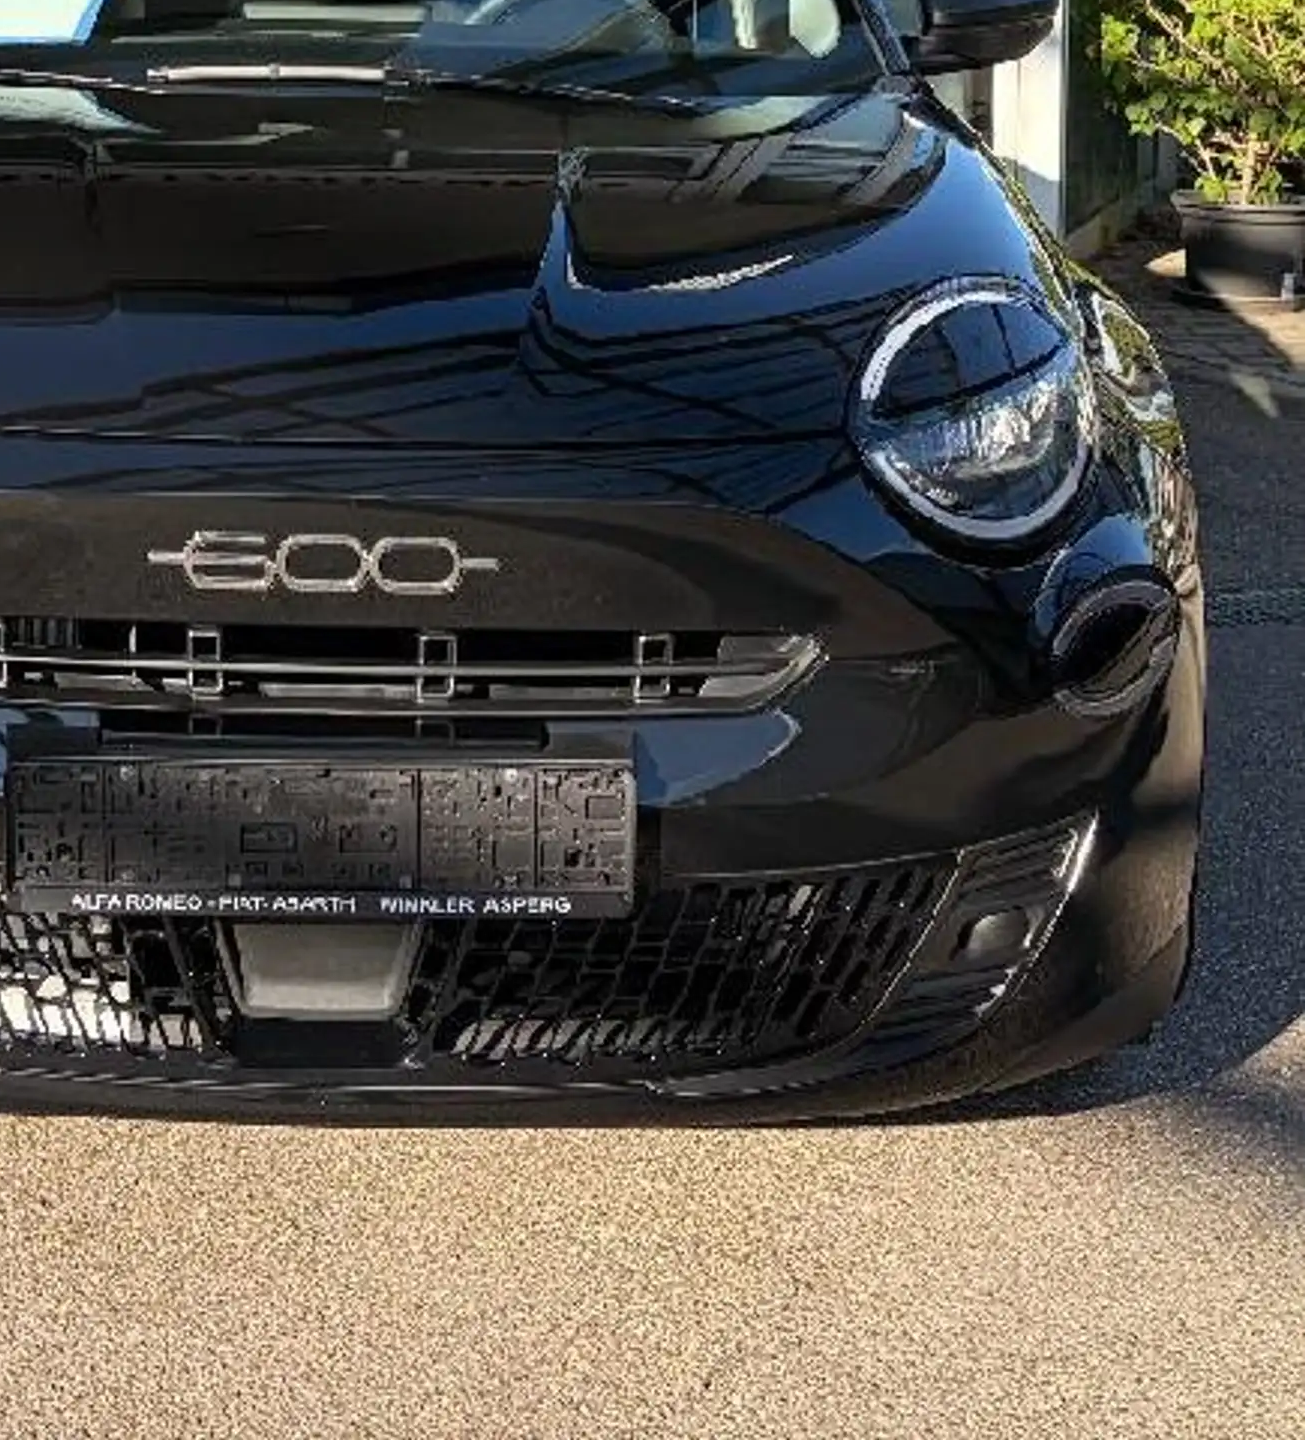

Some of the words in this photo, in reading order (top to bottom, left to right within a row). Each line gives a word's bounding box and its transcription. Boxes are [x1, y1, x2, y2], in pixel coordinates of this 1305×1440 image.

[71, 893, 122, 911] ALFA
[125, 894, 202, 911] ROMEO
[272, 896, 356, 914] ABARTH
[380, 896, 476, 914] WINKLER
[482, 896, 572, 914] ASPERG
